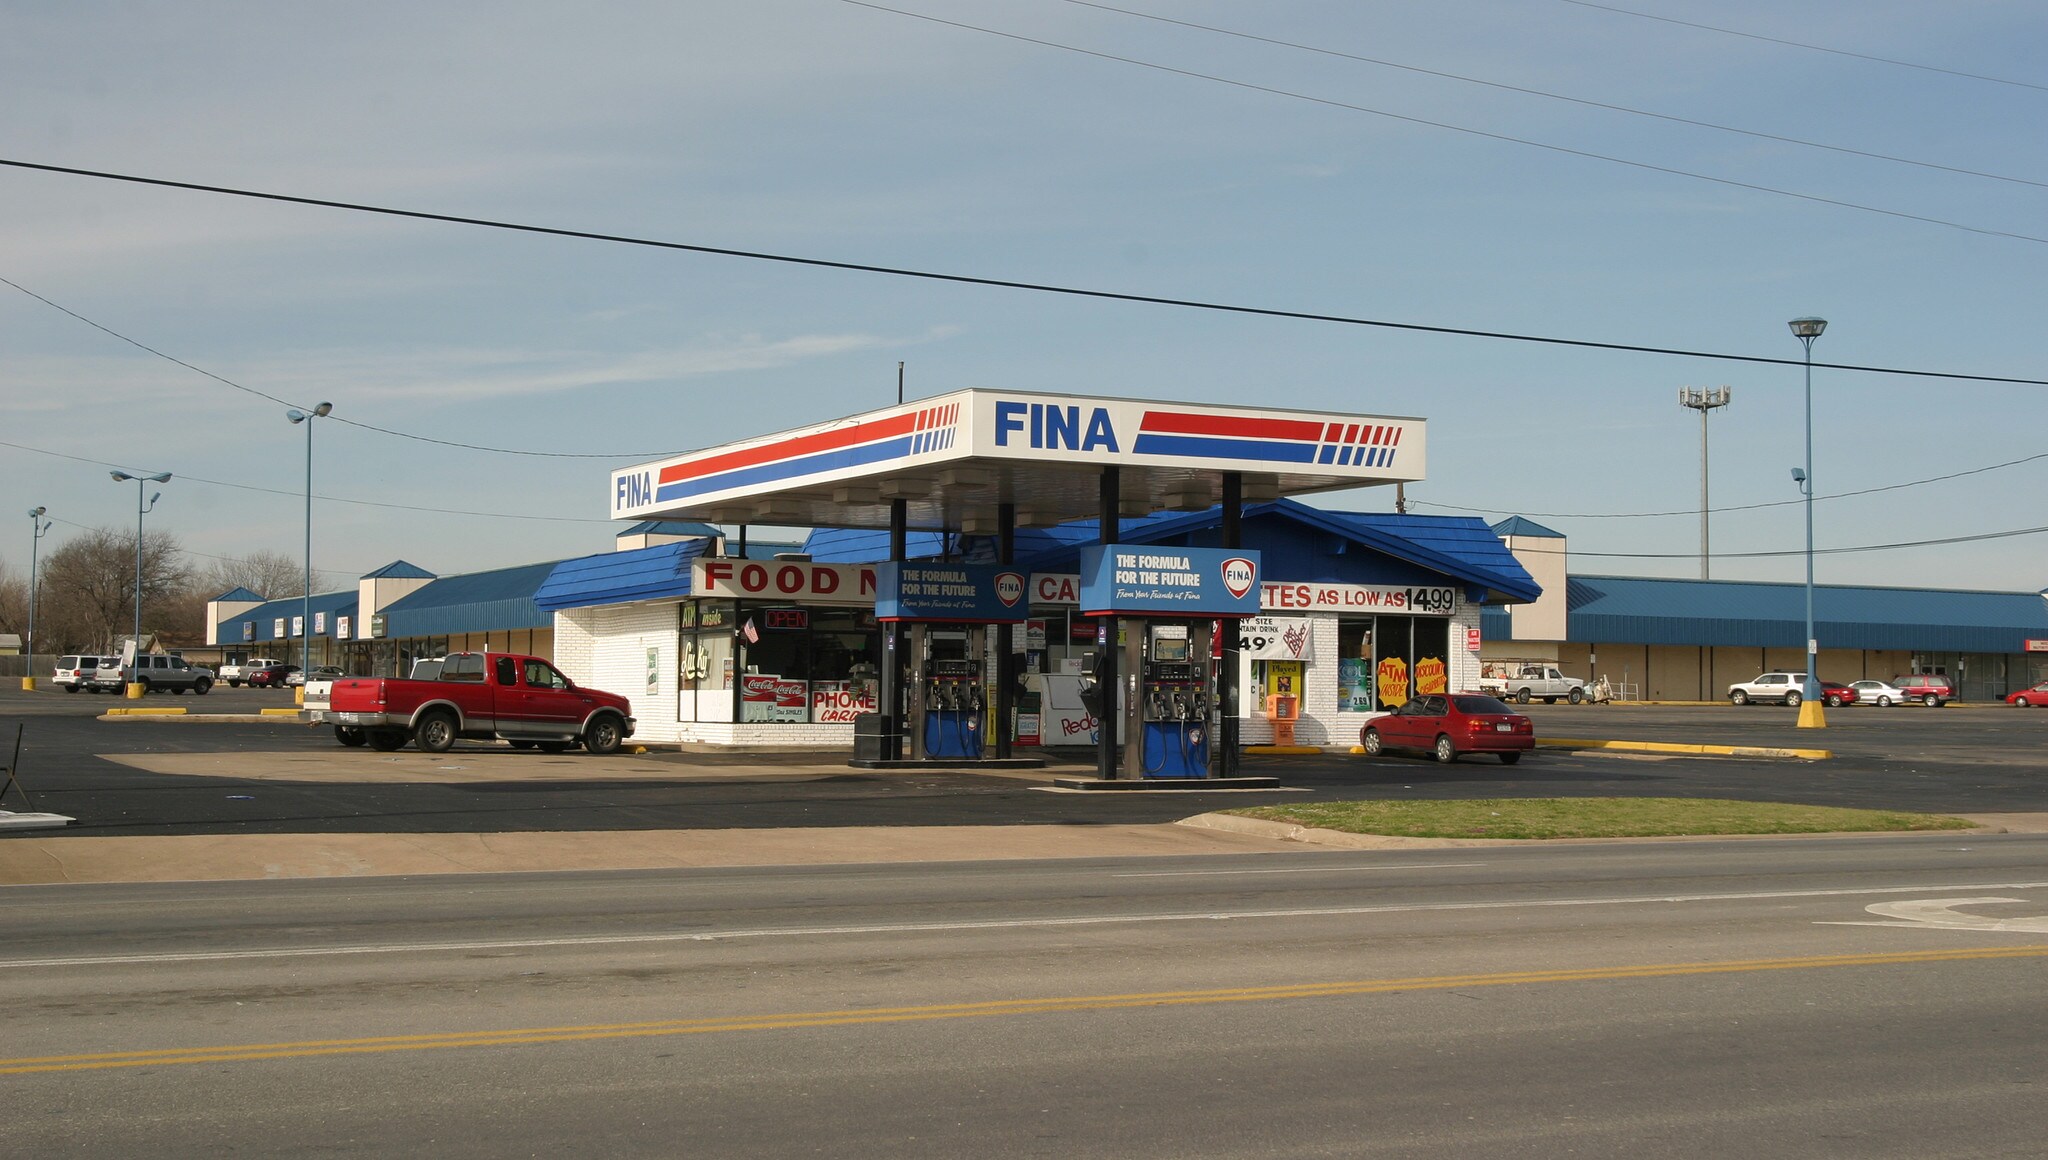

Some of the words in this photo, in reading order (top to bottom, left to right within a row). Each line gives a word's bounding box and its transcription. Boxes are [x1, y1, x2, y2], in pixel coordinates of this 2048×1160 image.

[994, 400, 1120, 453] FINA
[617, 471, 652, 510] FINA
[1116, 554, 1137, 568] THE
[1138, 555, 1190, 570] FORMULA
[705, 563, 839, 594] FOOD
[902, 569, 920, 581] THE
[921, 570, 967, 583] FORMULA
[1116, 570, 1137, 584] FOR
[1139, 571, 1159, 585] THE
[1161, 572, 1200, 587] FUTURE
[1227, 570, 1250, 581] FINA
[901, 583, 921, 595] FOR
[922, 584, 940, 596] THE
[941, 585, 976, 597] FUTURE
[1000, 584, 1021, 593] FINA
[1116, 588, 1134, 599] From
[1149, 589, 1174, 600] Friends
[1183, 591, 1201, 601] Fina
[1260, 585, 1311, 608] TES
[1316, 589, 1339, 606] AS
[1344, 590, 1380, 606] LOW
[1383, 591, 1405, 608] AS
[1404, 588, 1453, 612] 14.99
[682, 606, 696, 628] ATM
[701, 608, 722, 626] inside
[767, 611, 808, 627] OPEN
[1255, 617, 1273, 625] SIZE
[1271, 664, 1297, 674] Played
[1378, 661, 1407, 683] ATM
[1380, 683, 1405, 697] INSIDE
[814, 692, 877, 708] PHONE
